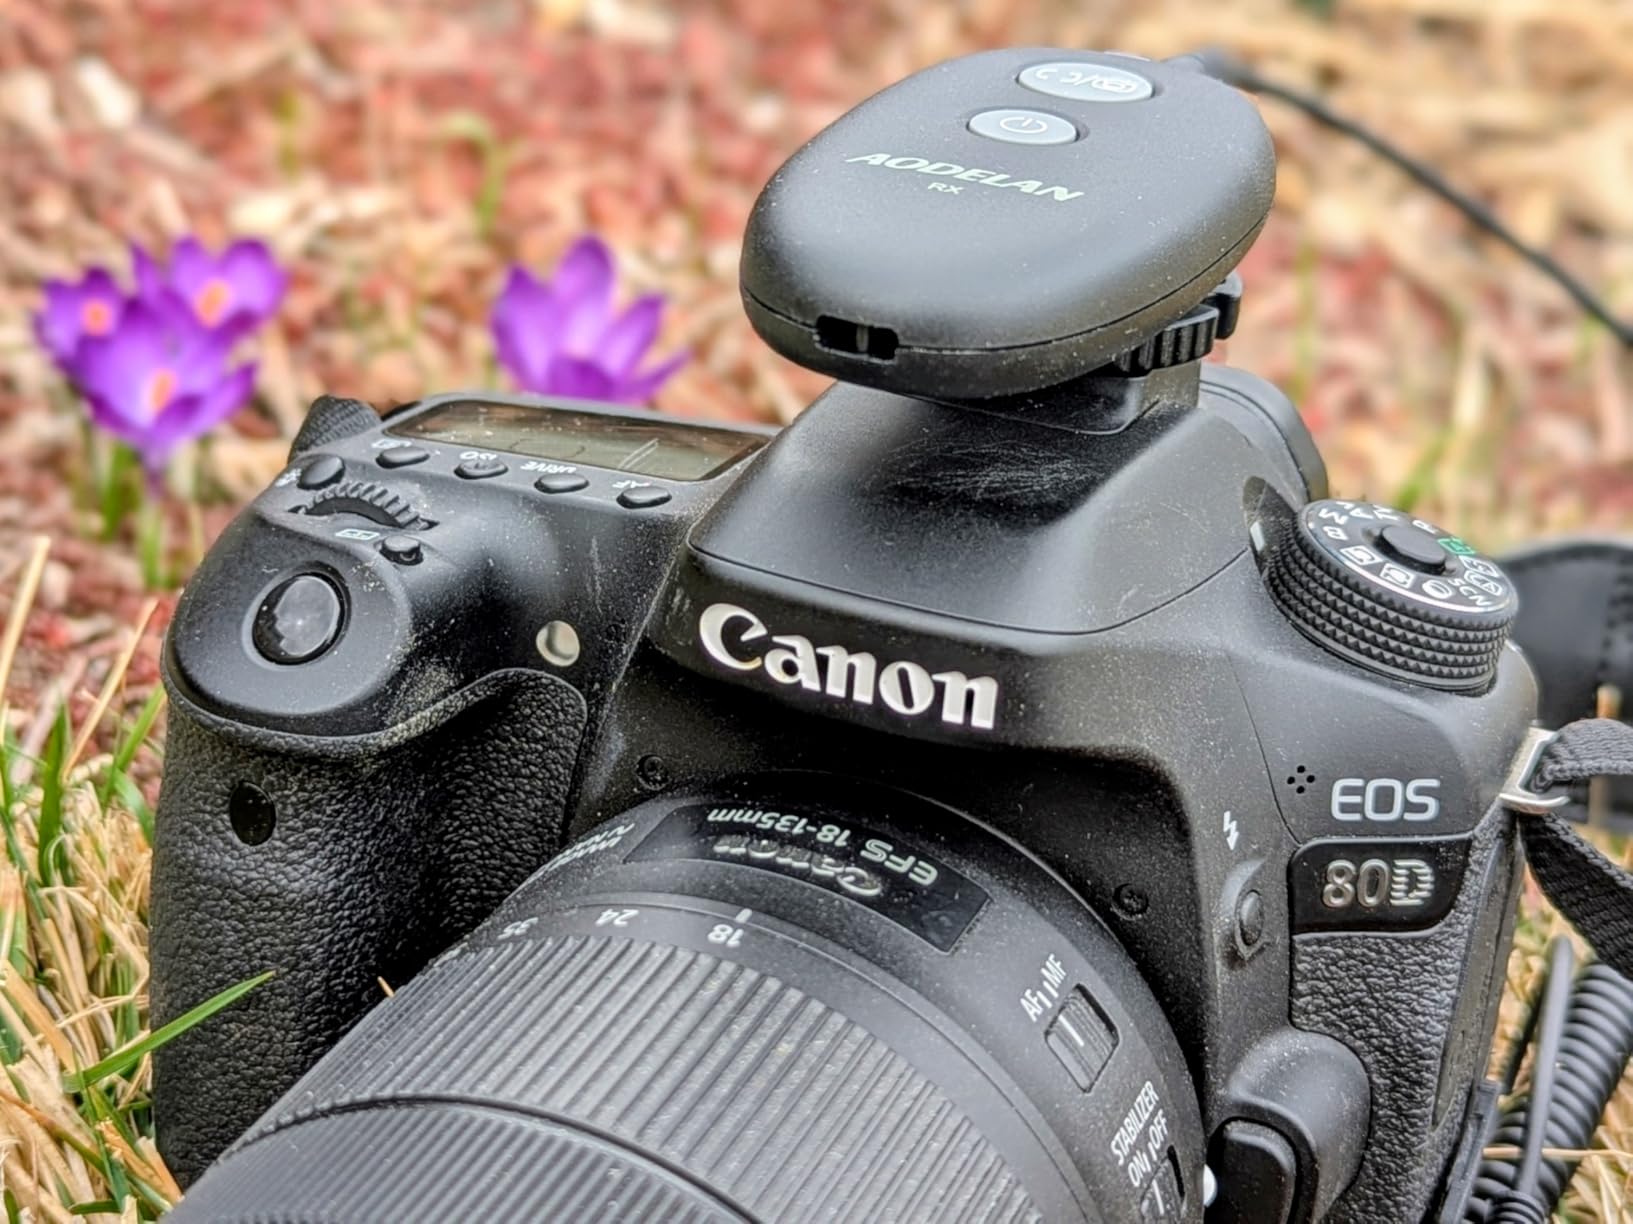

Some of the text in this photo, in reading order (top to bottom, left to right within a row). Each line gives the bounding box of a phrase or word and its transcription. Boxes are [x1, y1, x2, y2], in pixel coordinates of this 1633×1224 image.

[845, 152, 1084, 202] AODELAN
[927, 181, 964, 195] RX
[699, 602, 999, 730] Canon
[1331, 777, 1441, 822] EOS
[706, 807, 938, 886] EFS 18-135mm
[713, 834, 882, 896] Canon
[1322, 858, 1435, 908] 80D
[595, 908, 640, 926] 24
[707, 923, 745, 948] 18
[1019, 953, 1067, 1022] AF MF
[1110, 1080, 1160, 1167] STABILIZER
[1127, 1108, 1169, 1188] ON OFF
